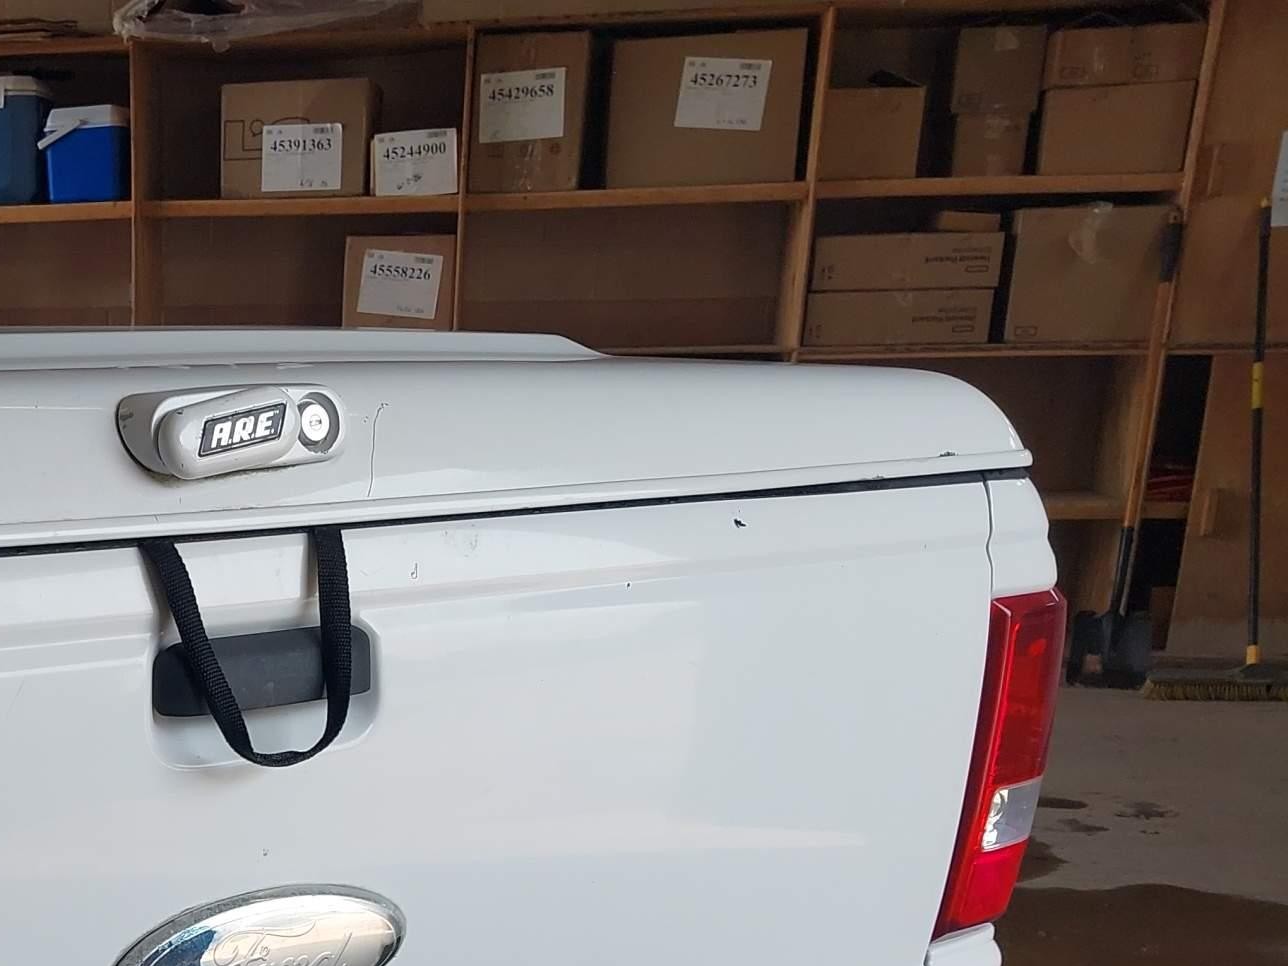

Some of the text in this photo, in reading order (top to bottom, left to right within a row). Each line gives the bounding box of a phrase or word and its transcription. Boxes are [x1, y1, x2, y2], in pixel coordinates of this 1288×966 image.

[690, 73, 758, 88] 45267273
[488, 84, 554, 101] 45429658
[270, 138, 332, 152] 45391363
[383, 142, 447, 160] 45244900
[370, 264, 431, 280] 45558226
